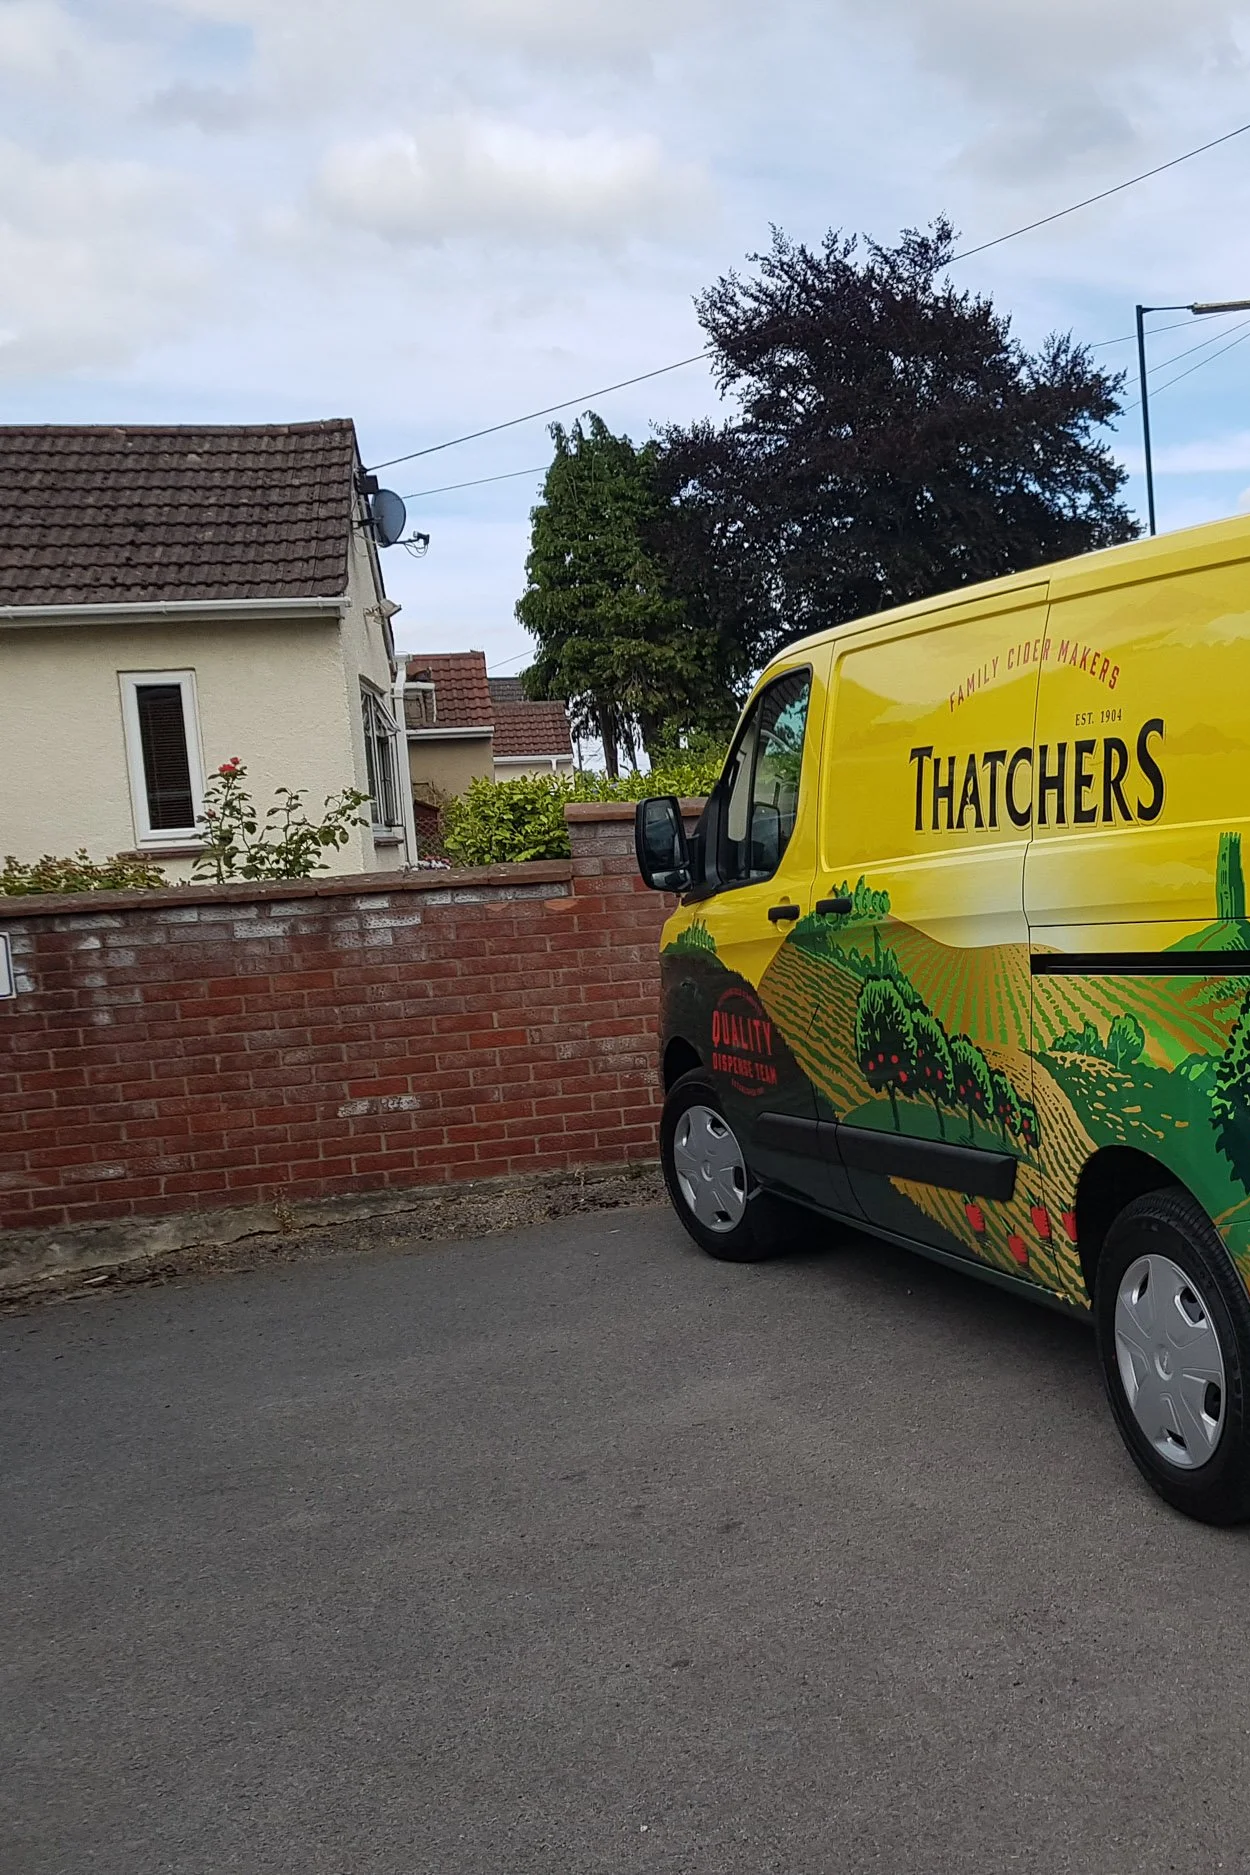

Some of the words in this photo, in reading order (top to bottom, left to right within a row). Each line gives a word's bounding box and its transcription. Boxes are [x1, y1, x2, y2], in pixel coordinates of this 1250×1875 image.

[949, 656, 999, 713] FAMILY
[1007, 637, 1051, 671] CIDER
[1057, 638, 1121, 690] MAKERS
[1075, 712, 1095, 726] EST.
[1100, 708, 1123, 724] 1904
[908, 717, 1166, 833] THATCHERS
[712, 1010, 772, 1055] QUALITY
[712, 1053, 754, 1078] DISPENSE
[755, 1062, 777, 1085] TEAM
